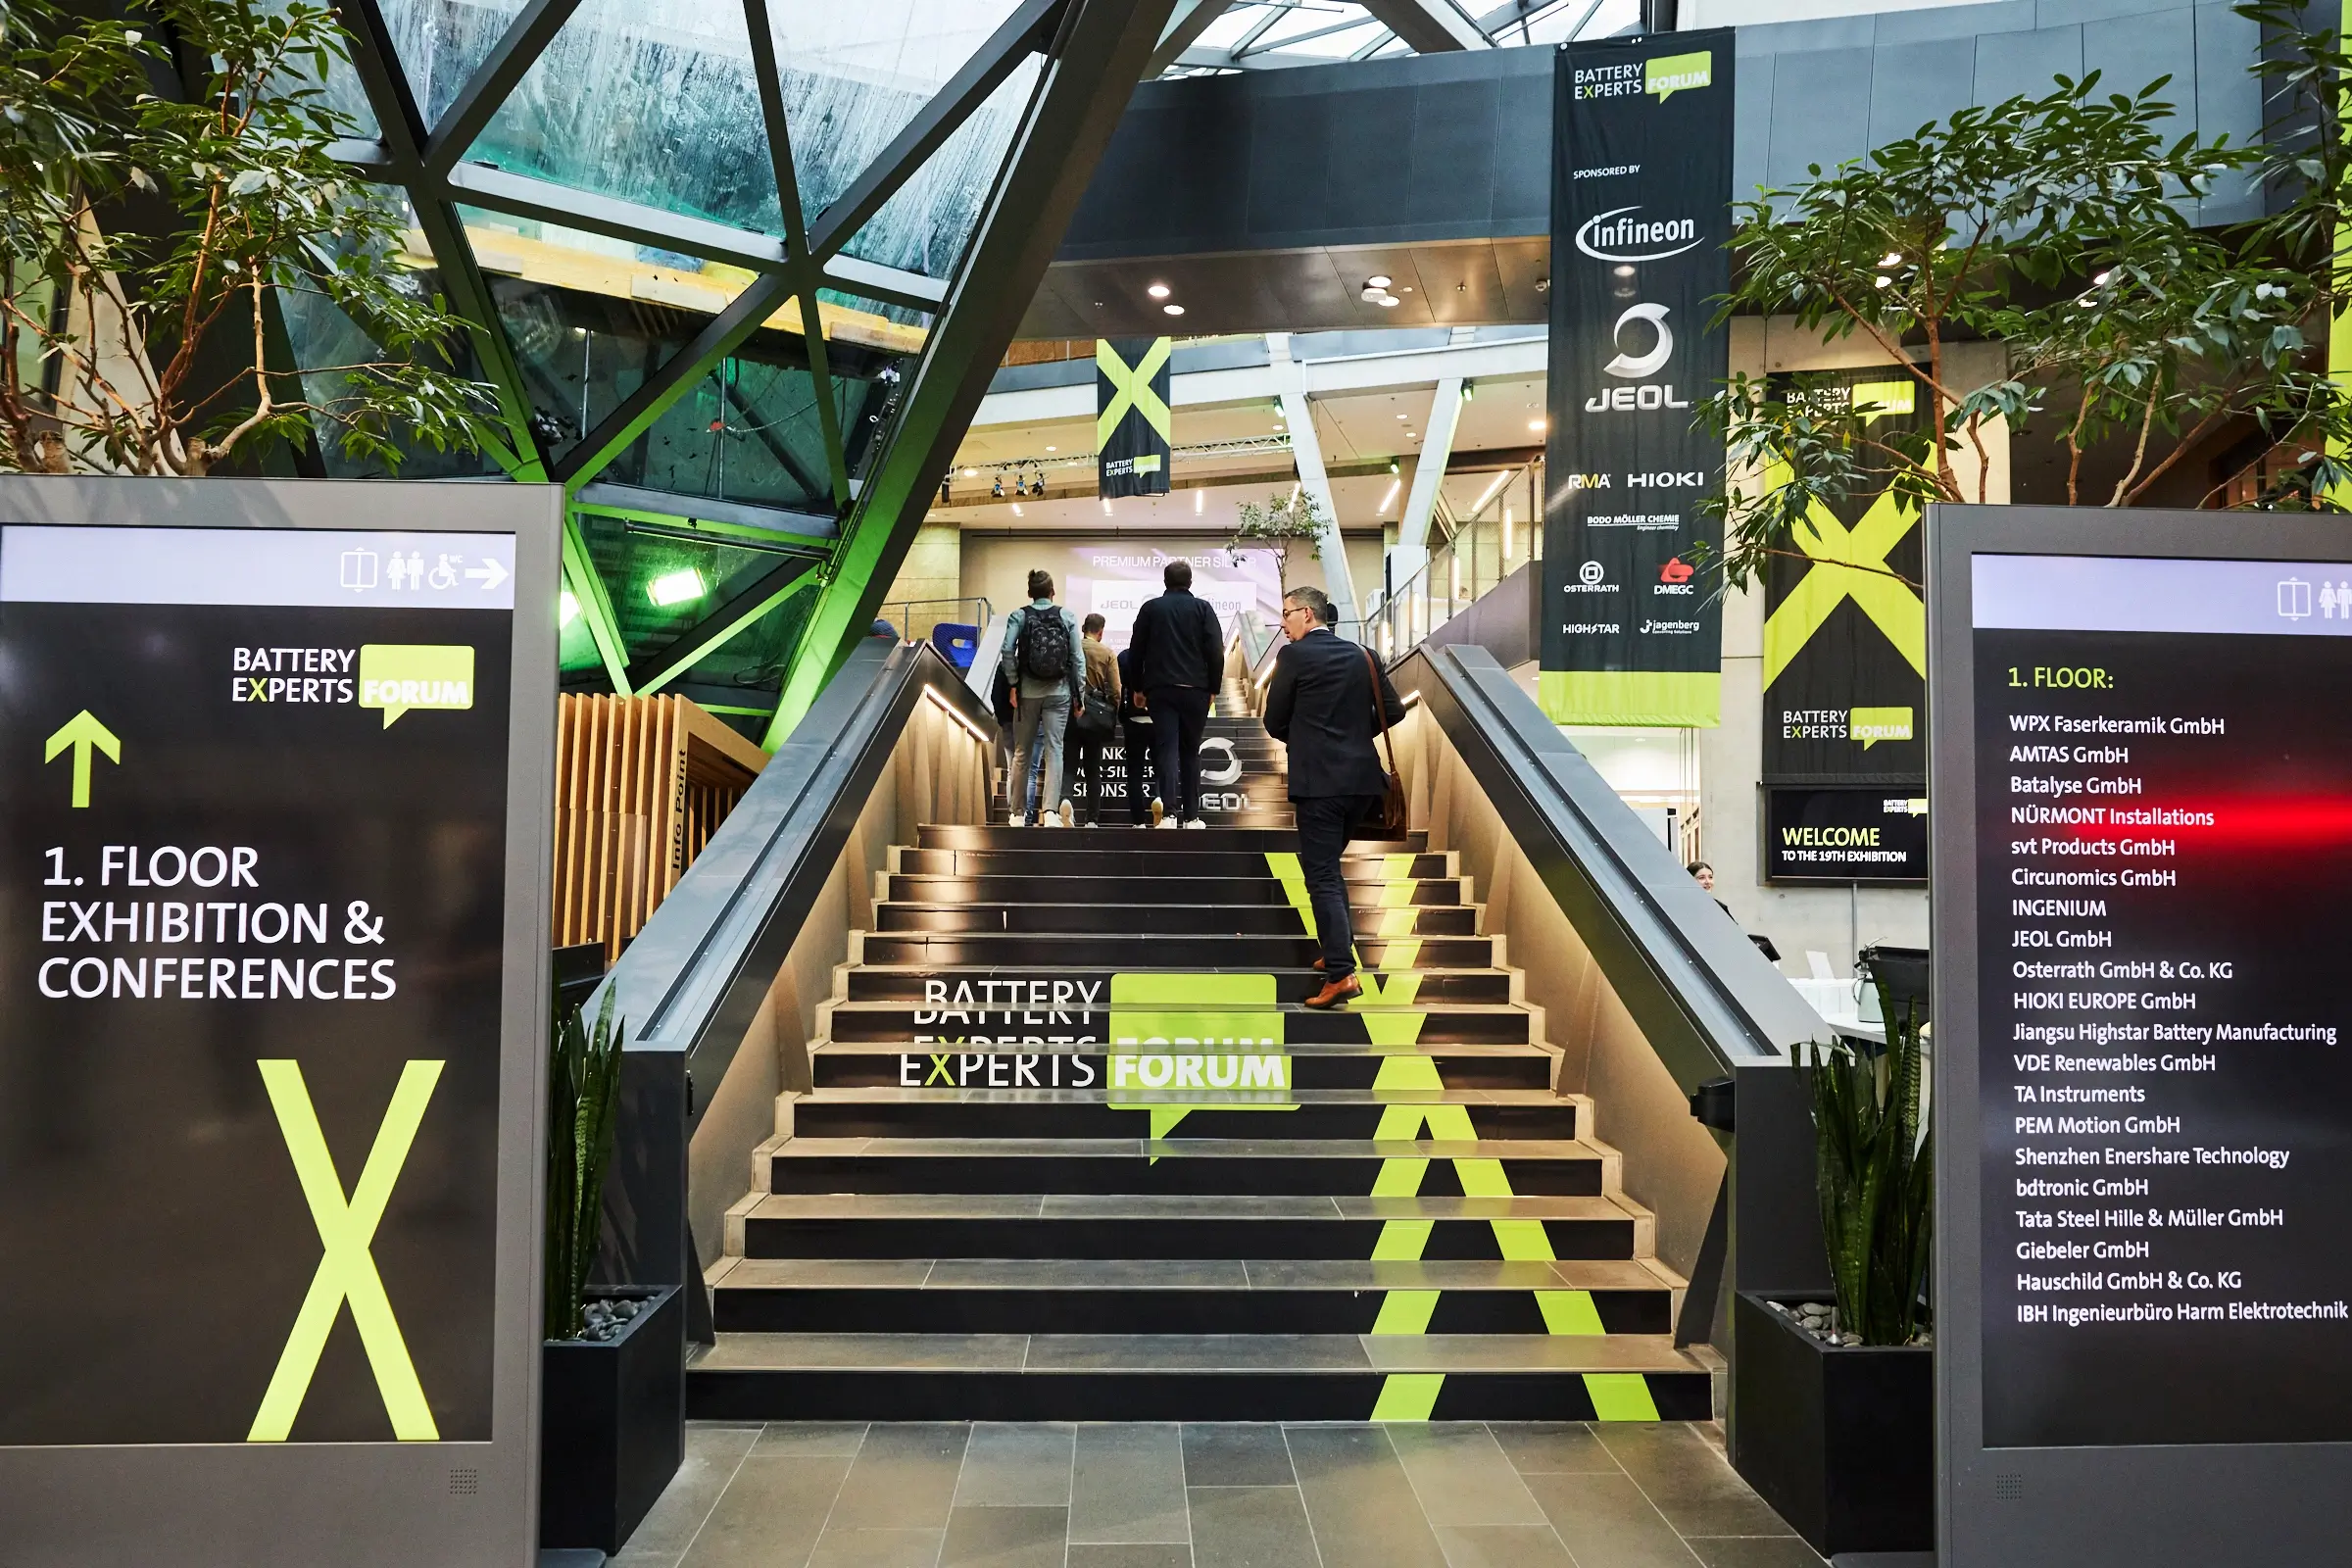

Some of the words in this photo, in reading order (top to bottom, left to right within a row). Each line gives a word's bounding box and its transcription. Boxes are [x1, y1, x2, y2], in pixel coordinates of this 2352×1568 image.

[1575, 63, 1642, 84] BATTERY
[1575, 79, 1642, 99] EXPERTS
[1648, 71, 1710, 90] FORUM
[1573, 166, 1627, 179] SPONSORED
[1629, 165, 1641, 173] BY
[1592, 216, 1694, 248] infineon
[1585, 385, 1689, 412] JEOL
[1787, 387, 1850, 403] BATERY
[1106, 459, 1133, 468] BATTERY
[1106, 466, 1133, 476] EXPERTS
[1568, 473, 1610, 489] RMA
[1628, 472, 1703, 487] HIOKI
[1614, 514, 1645, 523] MÖLLER
[1093, 556, 1151, 567] PREMIUM
[1654, 585, 1693, 595] DMEGC
[1101, 600, 1138, 610] JEOL
[1652, 619, 1699, 631] jagenberg
[233, 648, 356, 672] BATTERY
[2008, 667, 2028, 687] 1.
[2034, 667, 2114, 688] FLOOR:
[232, 677, 354, 704] EXPERTS
[364, 679, 470, 705] FORUM
[1783, 710, 1847, 723] BATTERY
[2010, 715, 2050, 732] WPX
[2054, 716, 2166, 734] Faserkeramik
[2170, 718, 2225, 735] GmbH
[1783, 725, 1847, 739] EXPERTS
[1853, 725, 1910, 738] FORUM
[2010, 746, 2069, 762] AMTAS
[2074, 747, 2129, 763] GmbH
[675, 749, 686, 813] Point
[2010, 776, 2082, 798] Batalyse
[2086, 777, 2141, 794] GmbH
[2011, 805, 2106, 824] NÜRMONT
[2110, 808, 2214, 826] Installations
[672, 823, 688, 869] Info
[1783, 827, 1880, 847] WELCOME
[2011, 841, 2036, 854] svt
[2042, 838, 2116, 856] Products
[2120, 840, 2175, 856] GmbH
[1782, 851, 1795, 860] TO
[1797, 851, 1817, 861] THE
[1819, 851, 1845, 861] 19TH
[1847, 852, 1906, 862] EXHIBITION
[43, 846, 83, 886] 1.
[102, 846, 259, 888] FLOOR
[2011, 868, 2117, 886] Circunomics
[2121, 869, 2176, 886] GmbH
[2013, 899, 2106, 917] INGENIUM
[42, 902, 328, 944] EXHIBITION
[344, 900, 385, 945] &
[2012, 930, 2052, 948] JEOL
[2057, 931, 2112, 947] GmbH
[38, 957, 397, 1000] CONFERENCES
[2013, 961, 2095, 979] Osterrath
[2100, 962, 2154, 979] GmbH
[2159, 961, 2175, 979] &
[2179, 962, 2205, 979] Co.
[2210, 962, 2232, 979] KG
[914, 980, 1102, 1025] BATTERY
[2014, 992, 2064, 1009] HIOKI
[2069, 993, 2136, 1009] EUROPE
[2141, 993, 2196, 1009] GmbH
[2013, 1023, 2075, 1045] Jiangsu
[2080, 1023, 2149, 1045] Highstar
[2154, 1024, 2212, 1045] Battery
[2216, 1023, 2337, 1045] Manufacturing
[900, 1036, 1097, 1087] EXPERTS
[1114, 1037, 1286, 1087] FORUM
[2014, 1054, 2050, 1071] VDE
[2055, 1054, 2156, 1071] Renewables
[2161, 1054, 2216, 1071] GmbH
[2015, 1086, 2036, 1102] TA
[2040, 1086, 2145, 1102] Instruments
[2015, 1116, 2053, 1133] PEM
[2058, 1116, 2120, 1134] Motion
[2125, 1116, 2180, 1133] GmbH
[2015, 1148, 2100, 1165] Shenzhen
[2105, 1148, 2189, 1164] Enershare
[2193, 1147, 2289, 1168] Technology
[2016, 1179, 2088, 1197] bdtronic
[2092, 1178, 2148, 1196] GmbH
[2016, 1210, 2052, 1227] Tata
[2057, 1209, 2100, 1227] Steel
[2105, 1209, 2143, 1227] Hille
[2148, 1208, 2163, 1227] &
[2168, 1208, 2224, 1227] Müller
[2229, 1208, 2283, 1226] GmbH
[2017, 1242, 2089, 1259] Giebeler
[2093, 1242, 2149, 1258] GmbH
[2017, 1273, 2102, 1291] Hauschild
[2107, 1272, 2162, 1290] GmbH
[2168, 1271, 2182, 1290] &
[2187, 1272, 2214, 1289] Co.
[2218, 1271, 2242, 1289] KG
[2018, 1305, 2047, 1322] IBH
[2052, 1303, 2173, 1327] Ingenieurbüro
[2178, 1303, 2224, 1320] Harm
[2229, 1301, 2348, 1320] Elektrotechnik
